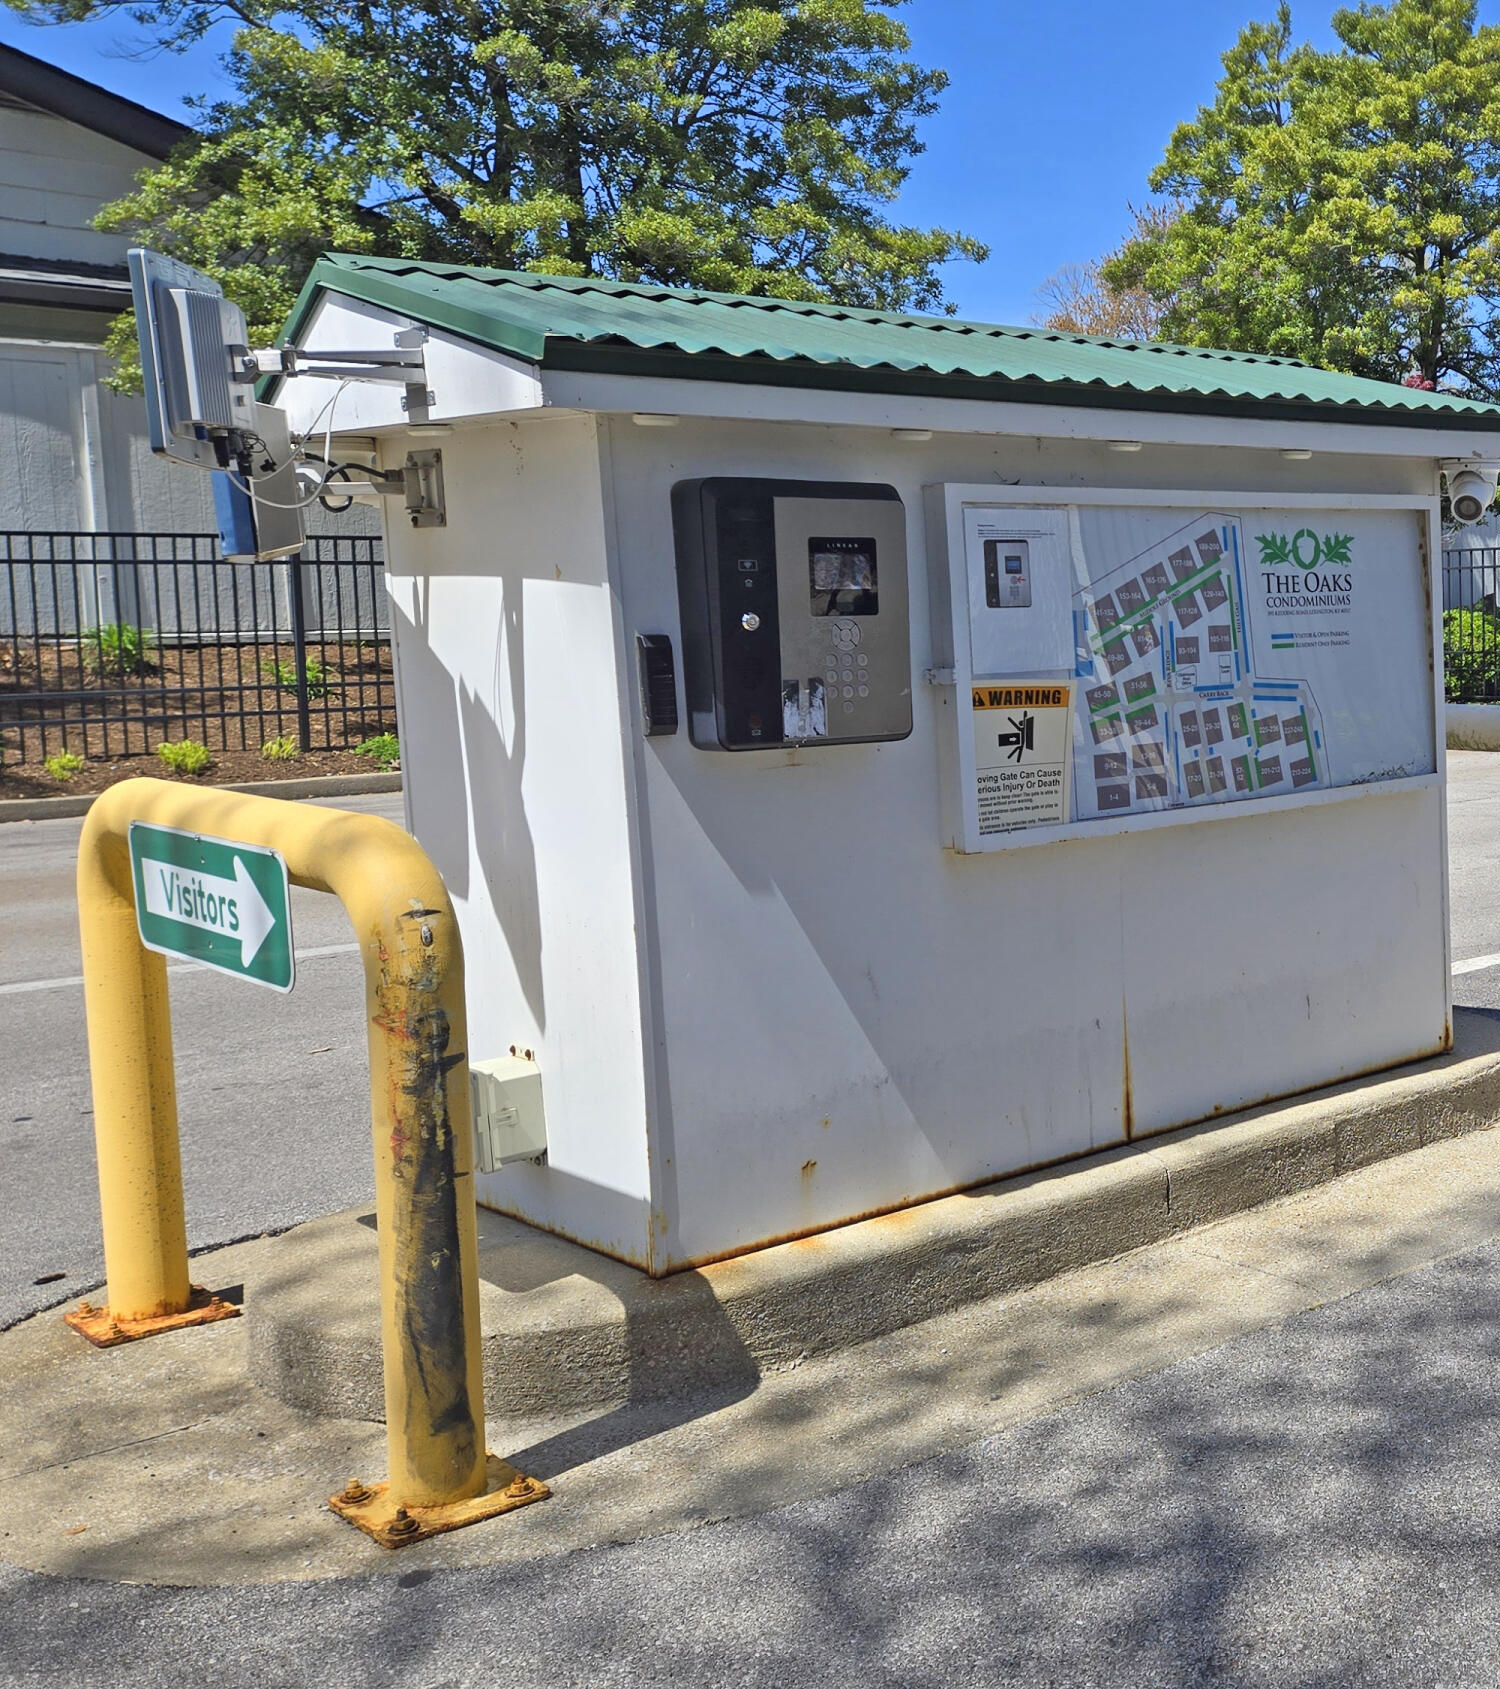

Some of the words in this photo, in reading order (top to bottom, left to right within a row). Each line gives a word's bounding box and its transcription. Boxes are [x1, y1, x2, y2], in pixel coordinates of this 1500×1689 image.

[1262, 572, 1300, 594] THE
[1304, 572, 1352, 593] OAKS
[1266, 594, 1350, 608] CONDOMINIUMS
[988, 690, 1062, 706] WARNING
[977, 775, 998, 784] oving
[1000, 773, 1018, 781] Gate
[1020, 771, 1035, 779] Can
[1037, 769, 1062, 778] Cause
[978, 785, 1000, 794] erious
[1003, 782, 1024, 792] Injury
[1038, 779, 1060, 788] Death
[160, 868, 239, 932] Visitors
